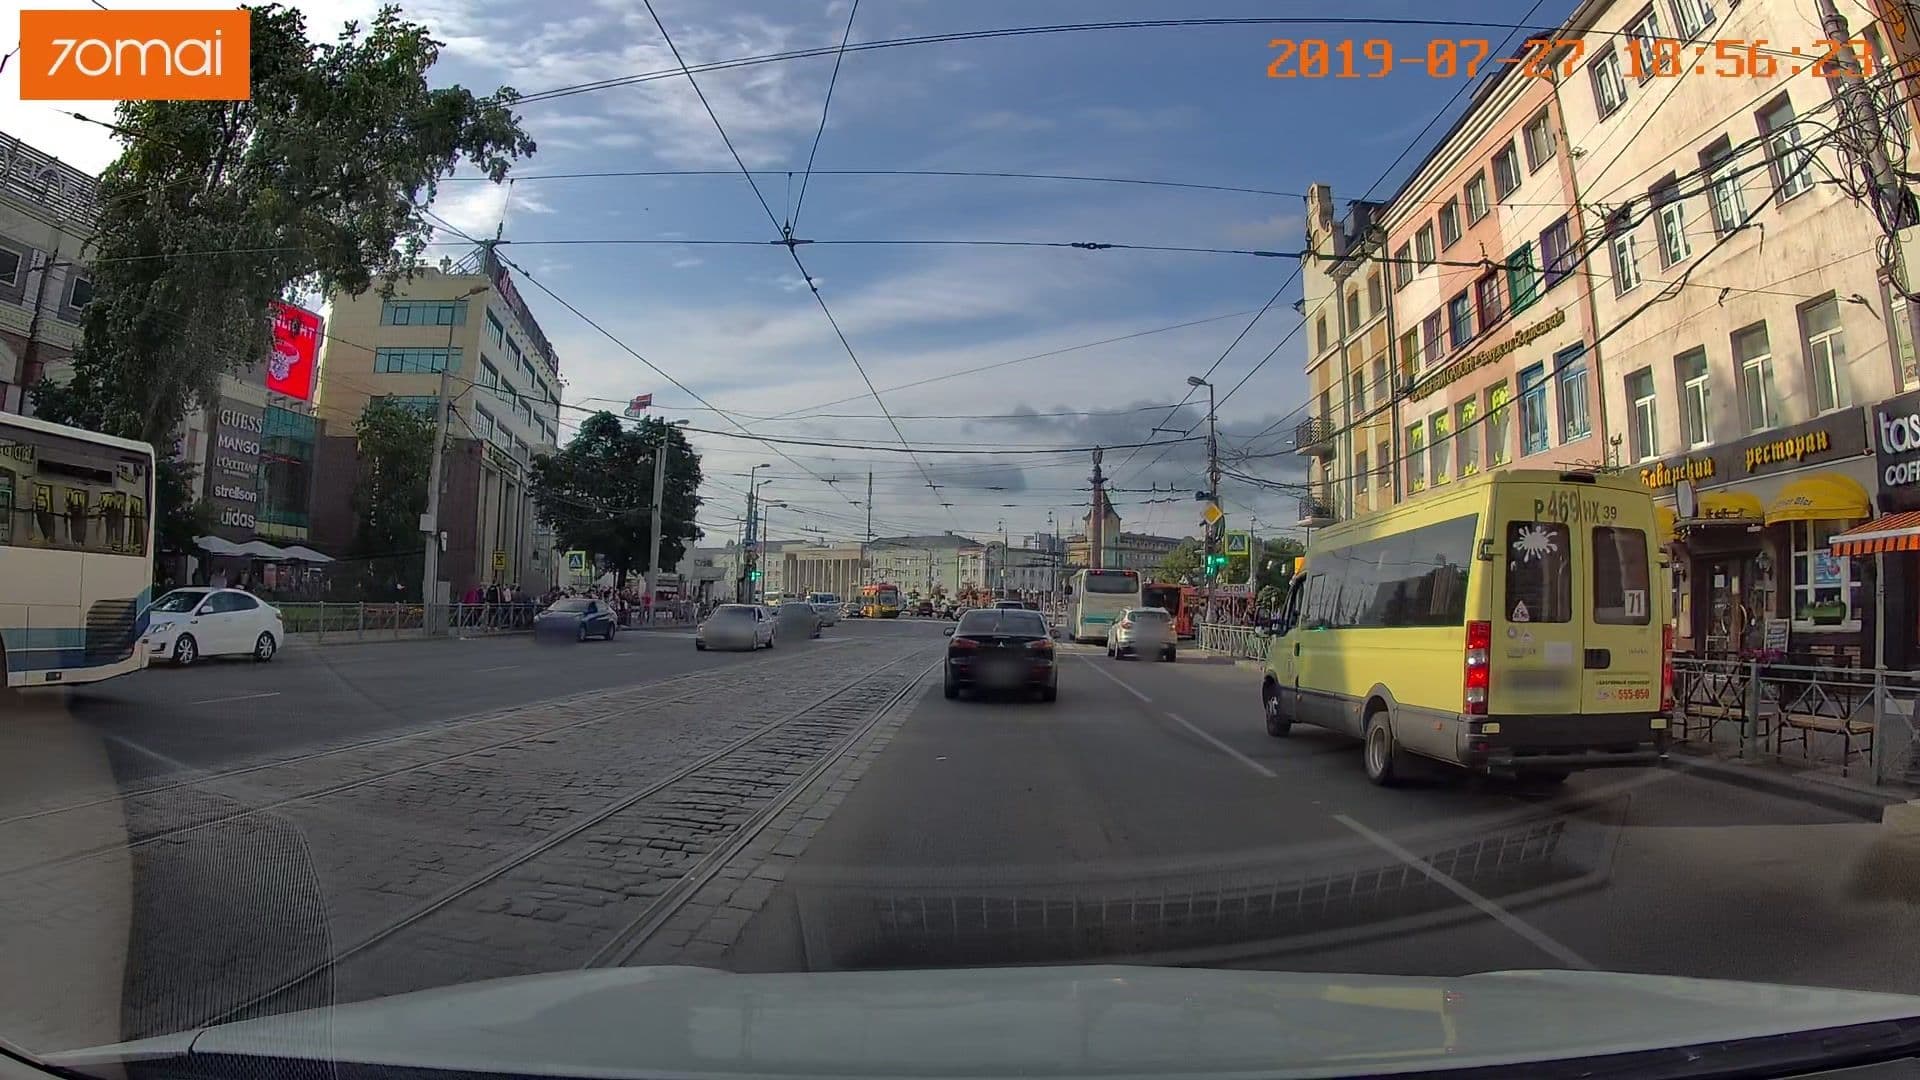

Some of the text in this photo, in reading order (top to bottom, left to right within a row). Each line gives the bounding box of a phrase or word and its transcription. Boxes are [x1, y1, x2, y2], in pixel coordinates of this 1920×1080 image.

[220, 409, 263, 435] GUESS
[217, 432, 260, 456] MANGO
[1744, 429, 1829, 472] ресторан
[214, 485, 257, 504] strellson
[1547, 489, 1580, 523] 469
[1603, 505, 1617, 520] 39
[221, 507, 255, 529] didas
[1628, 592, 1642, 614] 71
